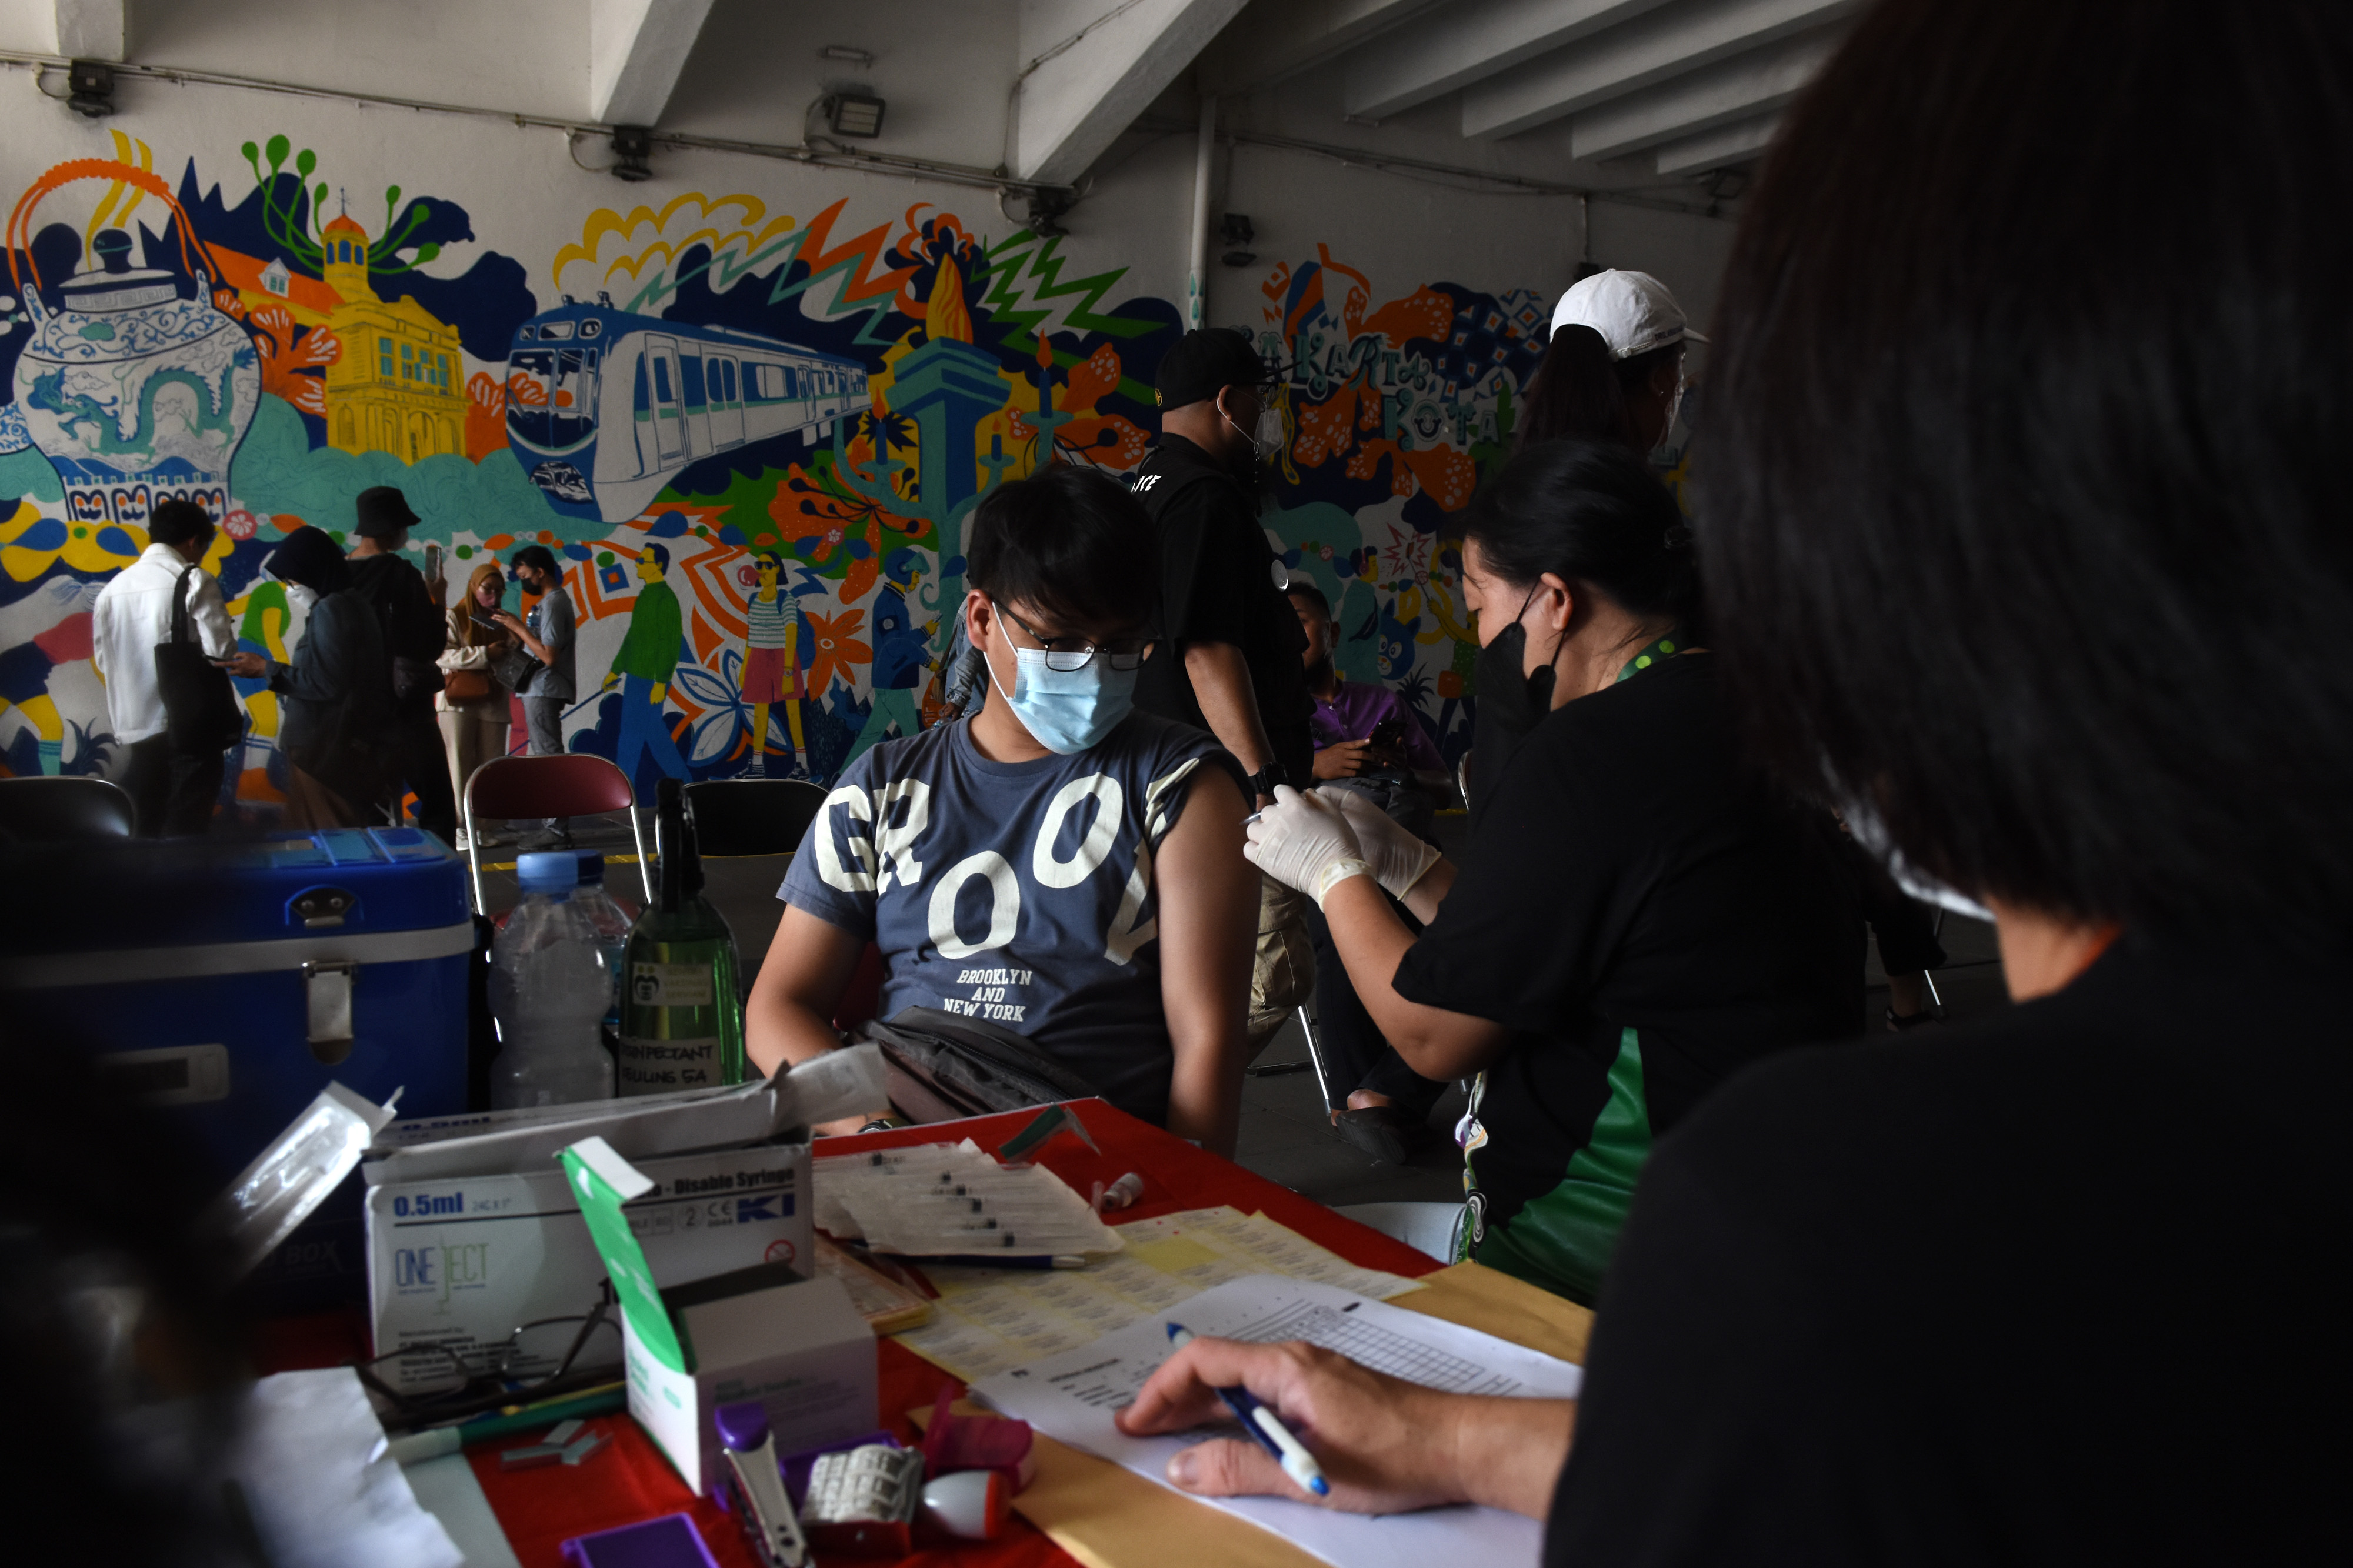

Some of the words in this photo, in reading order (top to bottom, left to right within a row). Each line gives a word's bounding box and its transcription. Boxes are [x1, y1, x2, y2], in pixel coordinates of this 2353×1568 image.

[1229, 325, 1433, 393] AKARTA
[1384, 388, 1502, 452] KOTA
[956, 968, 1032, 985] BROOKLYN
[971, 987, 1005, 1002] AND
[944, 998, 981, 1017] NEW
[983, 1003, 1026, 1022] YORK
[682, 1068, 707, 1083] 5A
[675, 1175, 733, 1195] Disable
[737, 1169, 794, 1187] Syringe
[394, 1192, 463, 1217] 0.5ml
